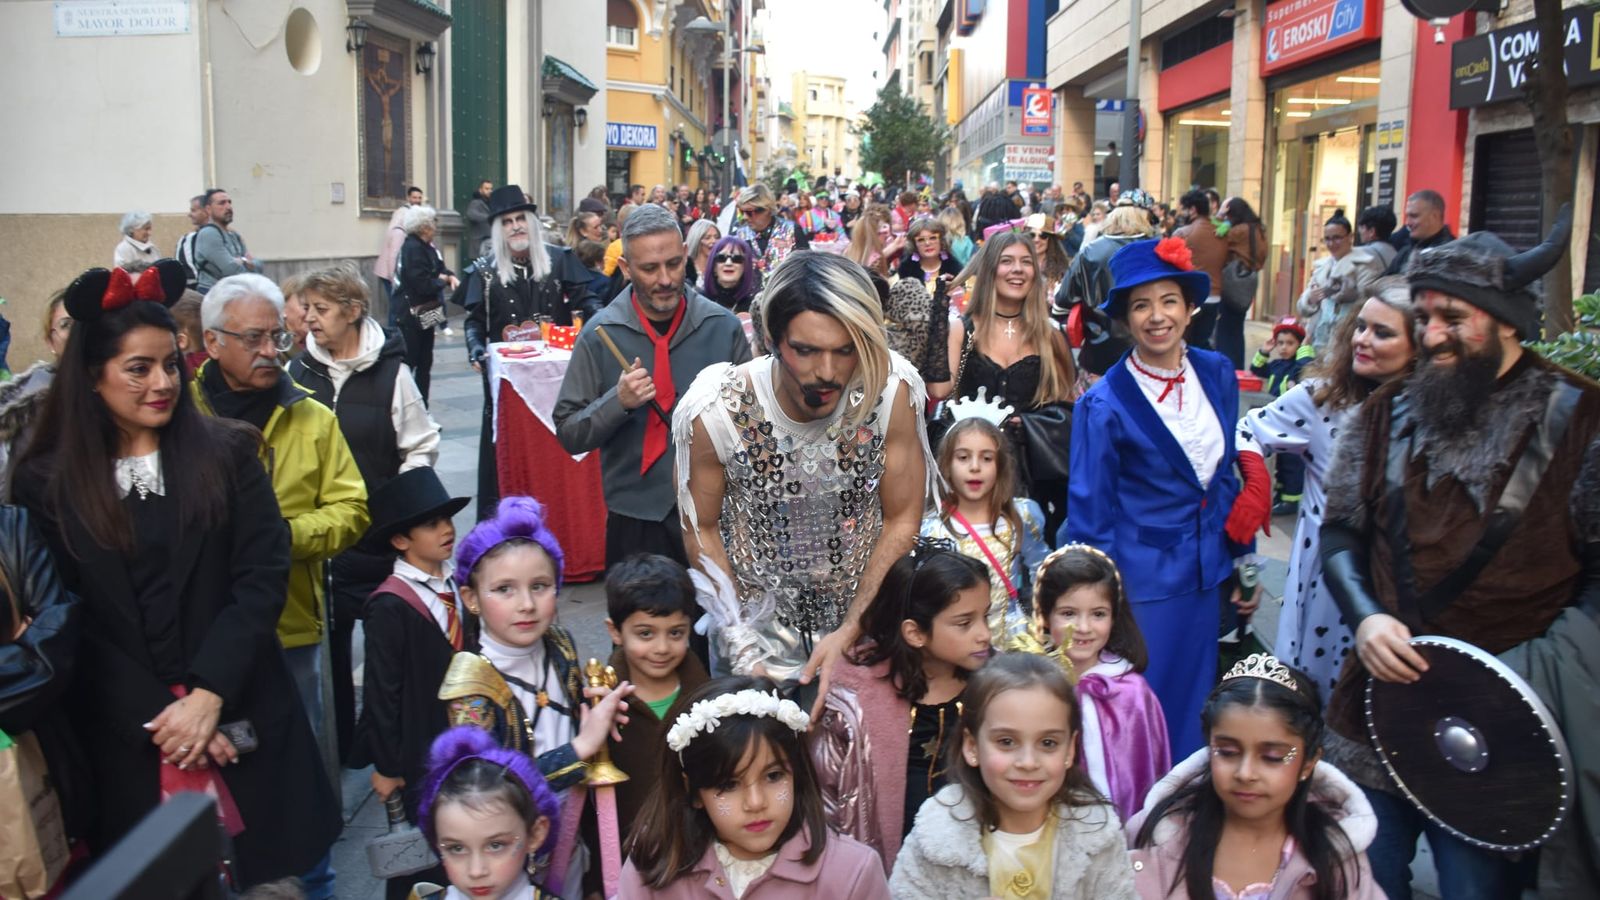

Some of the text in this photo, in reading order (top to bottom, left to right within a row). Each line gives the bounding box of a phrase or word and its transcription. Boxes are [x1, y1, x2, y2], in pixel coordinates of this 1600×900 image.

[77, 16, 177, 29] MAYOR DOLOR
[1283, 3, 1357, 50] EROSKI city
[1500, 17, 1581, 62] COMA
[607, 124, 656, 147] YO DEKORA
[1007, 146, 1049, 154] SE VEND
